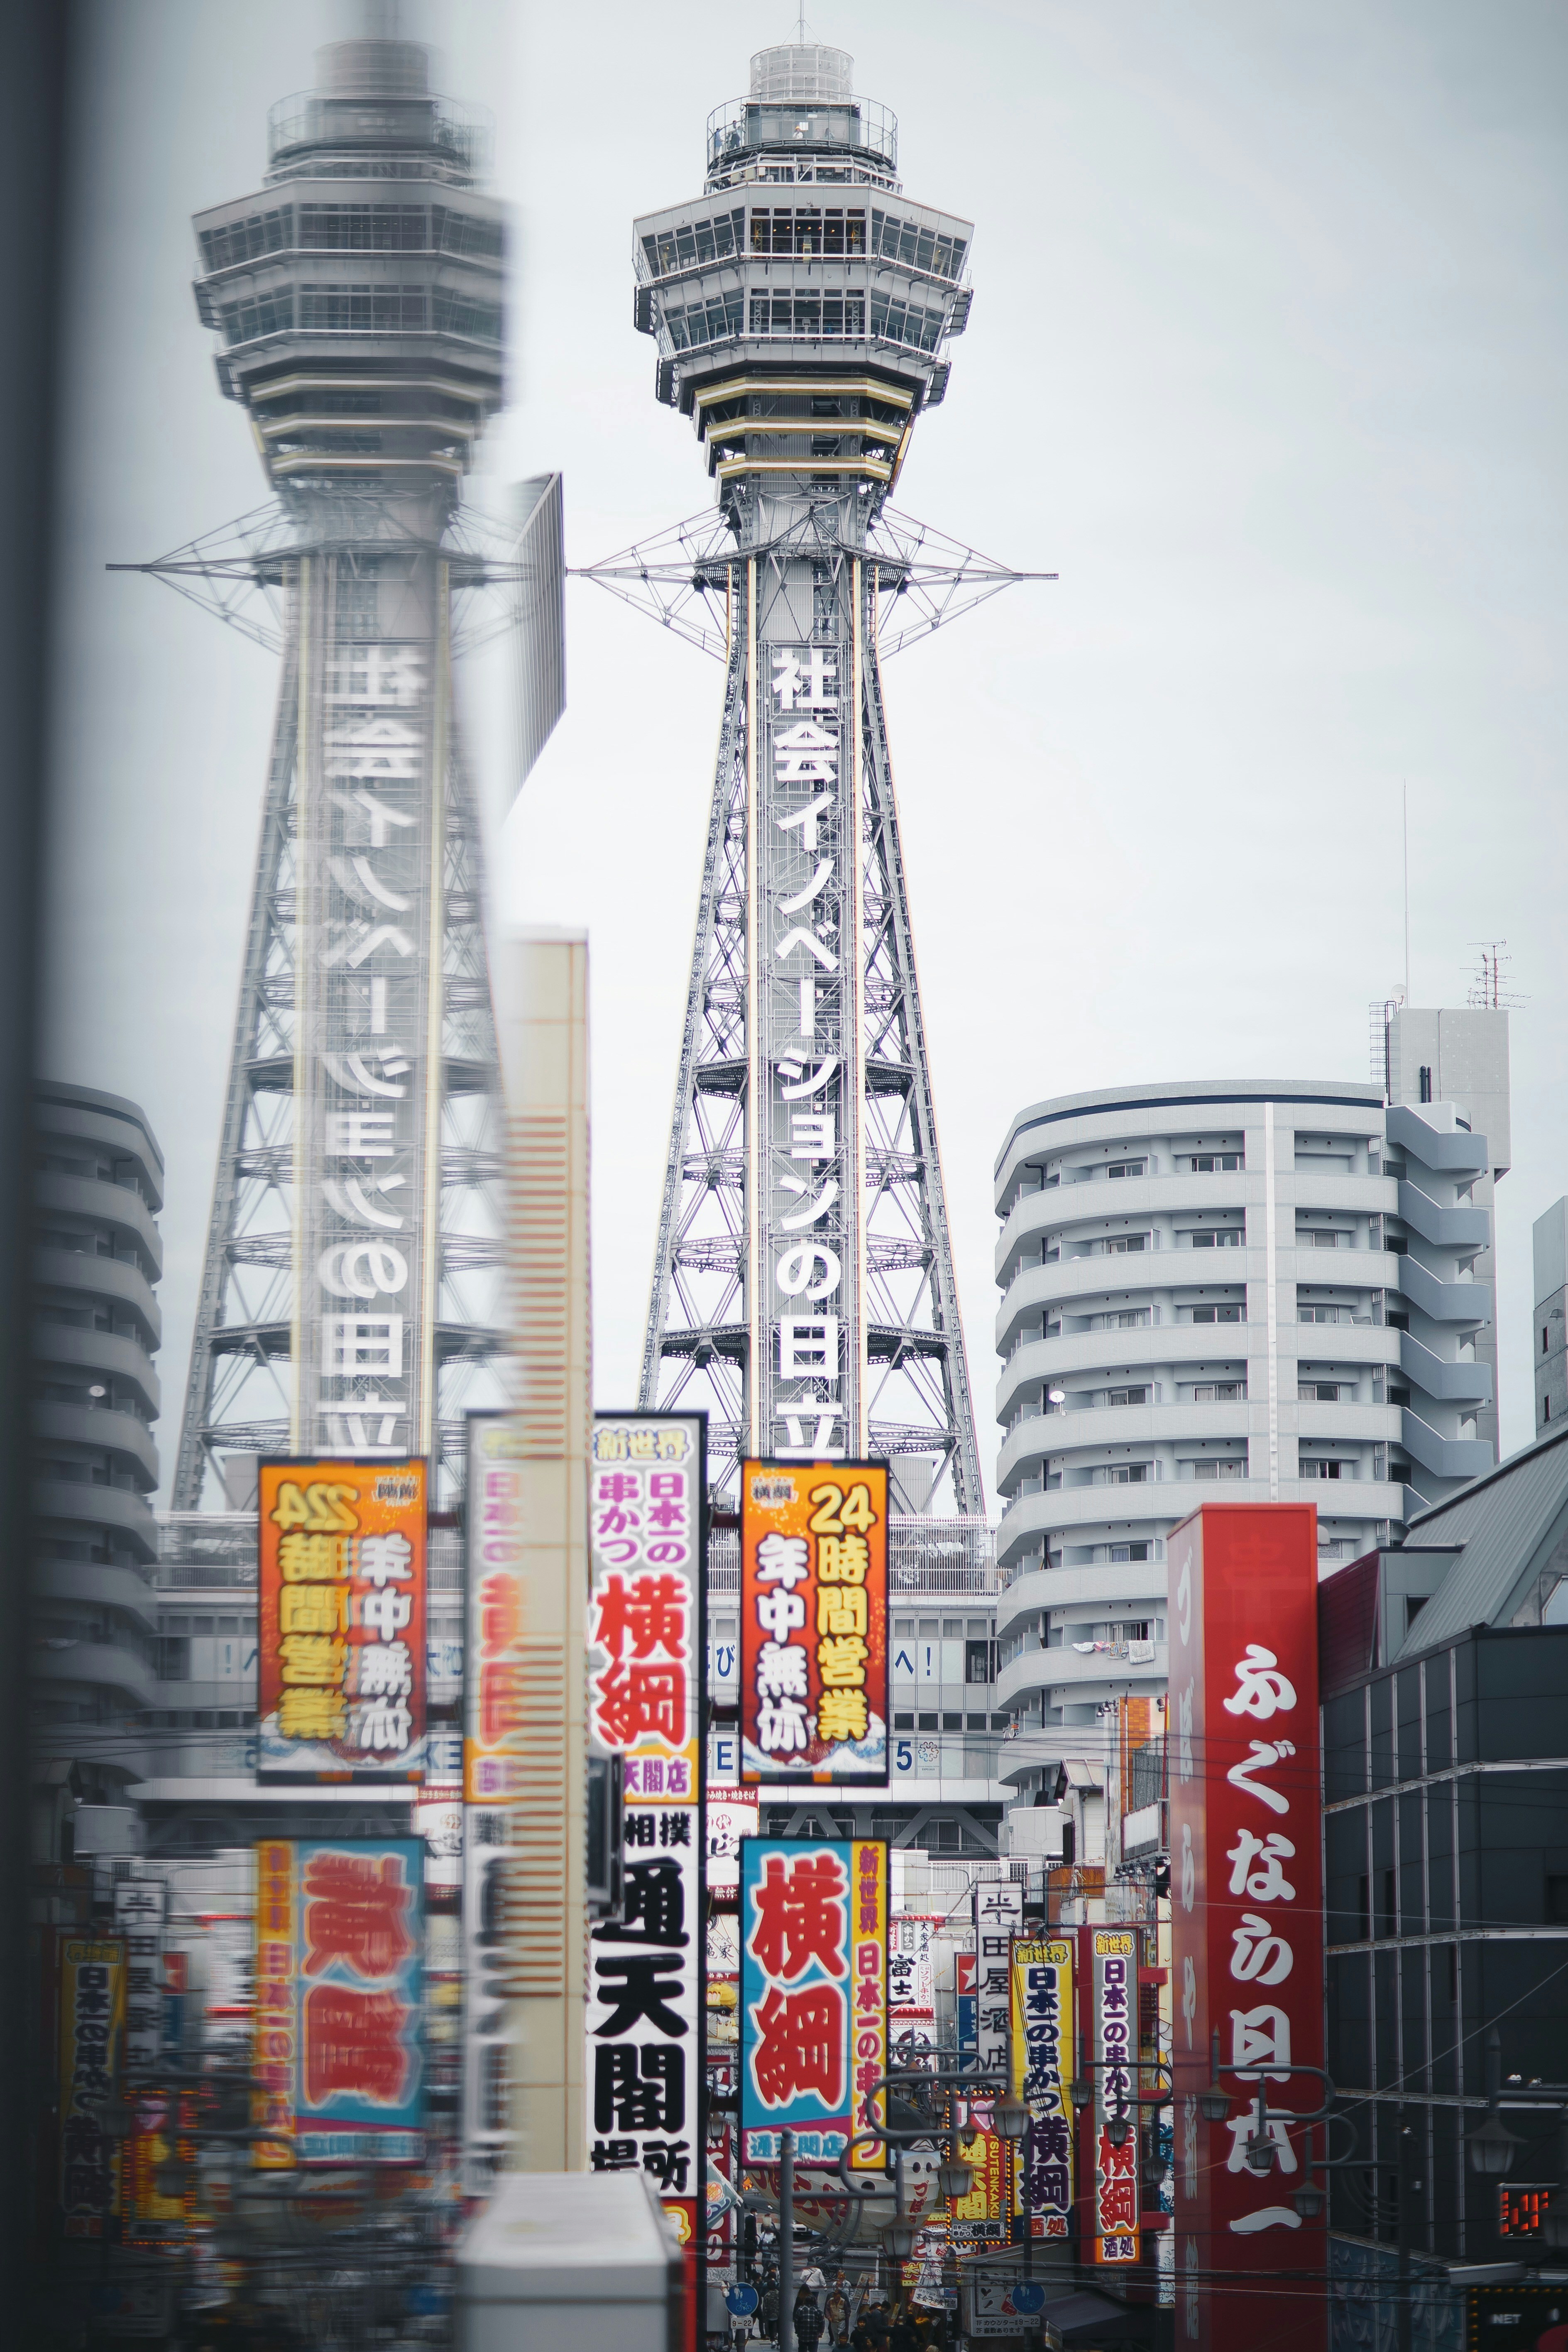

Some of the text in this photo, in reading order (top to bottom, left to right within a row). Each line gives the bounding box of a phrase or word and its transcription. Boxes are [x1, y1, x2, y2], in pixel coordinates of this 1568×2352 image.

[772, 649, 844, 1459] 社会イノベーションの日立
[596, 1429, 689, 1461] 新世界
[597, 1473, 640, 1562] 串かつ
[647, 1473, 687, 1562] 日本一の
[756, 1533, 809, 1752] 年中無休
[809, 1484, 877, 1741] 24時間営業
[594, 1575, 687, 1746] 横綱
[897, 1741, 912, 1771] 5
[625, 1812, 692, 1848] 相撲
[859, 1846, 879, 1934] 新世界
[752, 1855, 847, 2106] 横綱
[1017, 1945, 1068, 1963] 新世界
[1096, 1934, 1133, 1954] 新世界
[592, 1857, 690, 2134] 通天閣
[1025, 1967, 1060, 2111] 日本一の串かつ
[857, 1943, 881, 2160] 日本一の串かつ
[1104, 2237, 1135, 2257] 酒処
